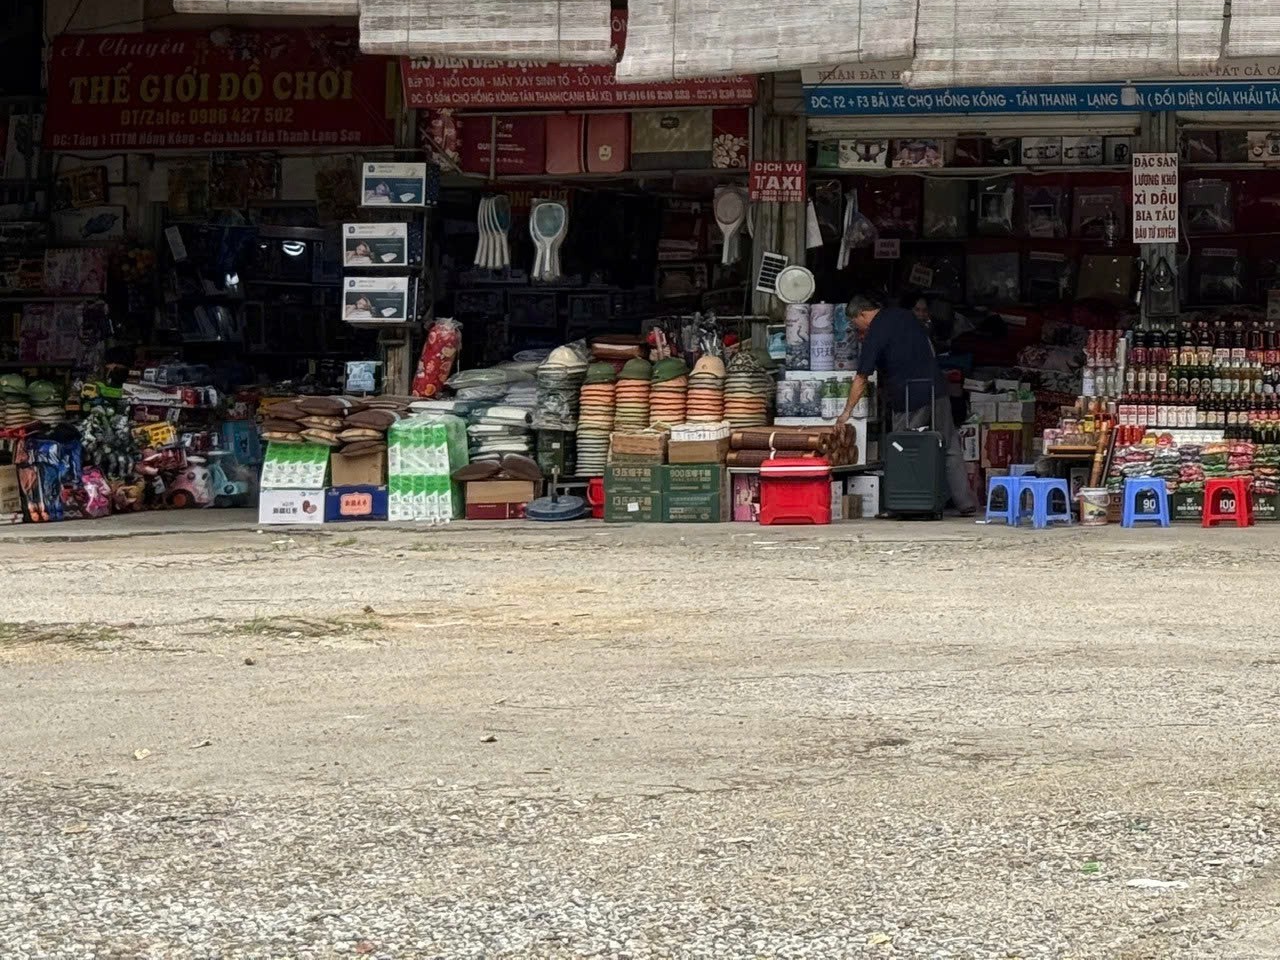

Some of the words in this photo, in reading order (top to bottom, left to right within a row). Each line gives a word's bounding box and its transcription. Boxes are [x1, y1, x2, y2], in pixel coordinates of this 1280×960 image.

[69, 62, 132, 105] THẾ
[138, 64, 210, 103] GIỚI
[217, 57, 265, 103] ĐỒ
[271, 64, 354, 102] CHƠI
[811, 95, 832, 109] ĐC:
[833, 95, 846, 108] F2
[856, 95, 869, 107] F3
[871, 91, 889, 108] BÃI
[891, 95, 905, 107] XE
[907, 93, 934, 110] CHỢ
[936, 90, 971, 108] HỒNG
[972, 90, 1007, 108] KÔNG
[1017, 90, 1039, 107] TÂN
[1040, 92, 1078, 107] THANH
[1087, 92, 1119, 111] LẠNG
[1154, 87, 1175, 106] ĐỐI
[1178, 89, 1203, 108] DIỆN
[1206, 86, 1233, 105] CỬA
[1233, 85, 1264, 105] KHẨU
[754, 162, 783, 173] DỊCH
[785, 162, 803, 174] VỤ
[753, 175, 803, 191] TAXI
[1134, 189, 1147, 205] XÌ
[1150, 186, 1177, 205] DẦU
[1135, 210, 1153, 222] BIA
